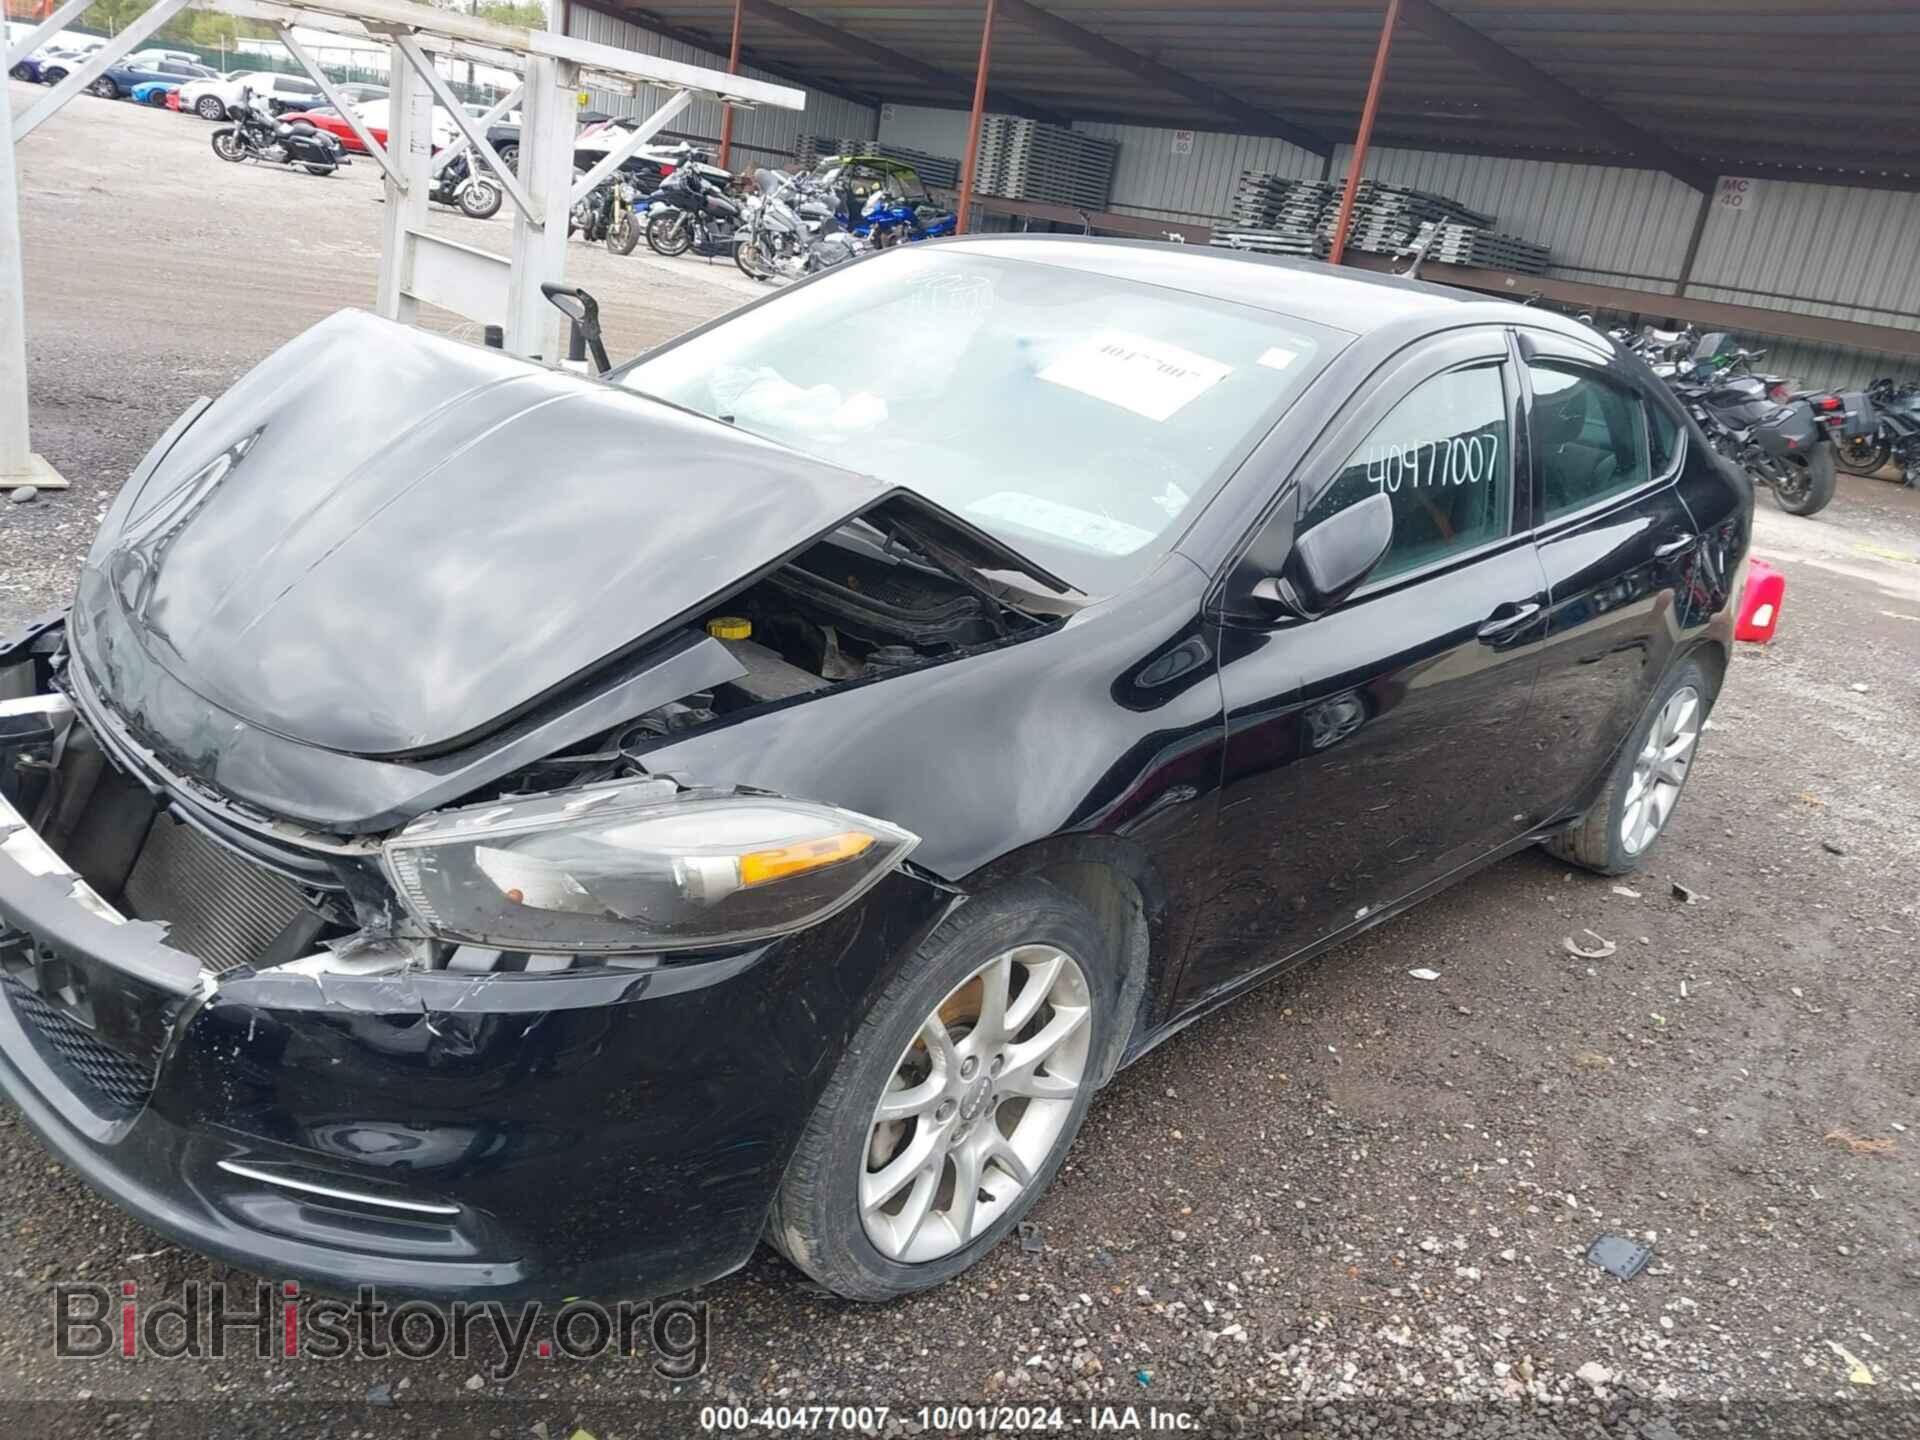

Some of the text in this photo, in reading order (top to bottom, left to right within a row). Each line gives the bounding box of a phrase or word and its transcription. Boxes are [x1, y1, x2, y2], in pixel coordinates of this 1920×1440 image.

[1722, 179, 1749, 192] MC
[1721, 194, 1743, 207] 40
[1367, 434, 1498, 493] 40477007
